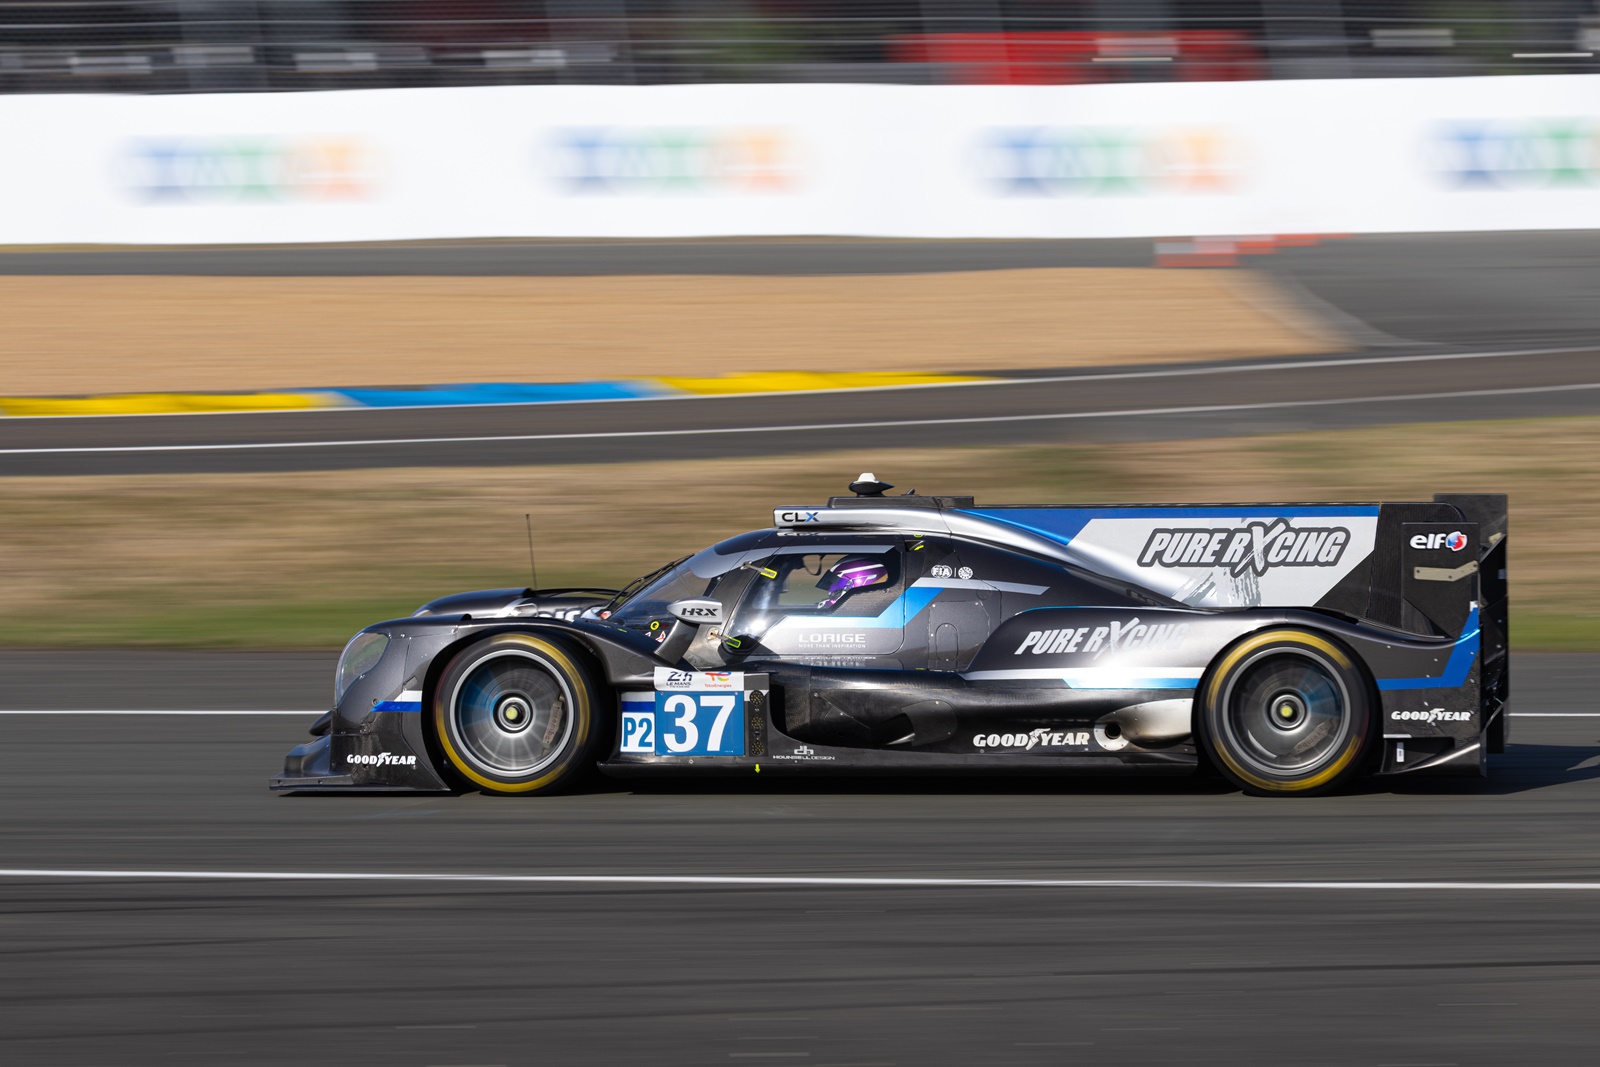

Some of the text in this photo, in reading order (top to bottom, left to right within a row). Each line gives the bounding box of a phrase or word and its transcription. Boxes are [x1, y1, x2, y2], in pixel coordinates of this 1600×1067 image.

[781, 511, 820, 523] CLX
[1140, 531, 1228, 565] PURE
[1409, 533, 1447, 549] elf
[932, 566, 951, 577] FIA
[681, 607, 719, 617] HRX
[798, 632, 866, 643] LORIGE
[1013, 626, 1090, 655] PURE
[663, 694, 736, 752] 37
[1391, 708, 1471, 723] GOODYEAR
[622, 716, 653, 748] P2
[972, 728, 1091, 750] GOODYEAR
[346, 752, 417, 767] GOODYEAR
